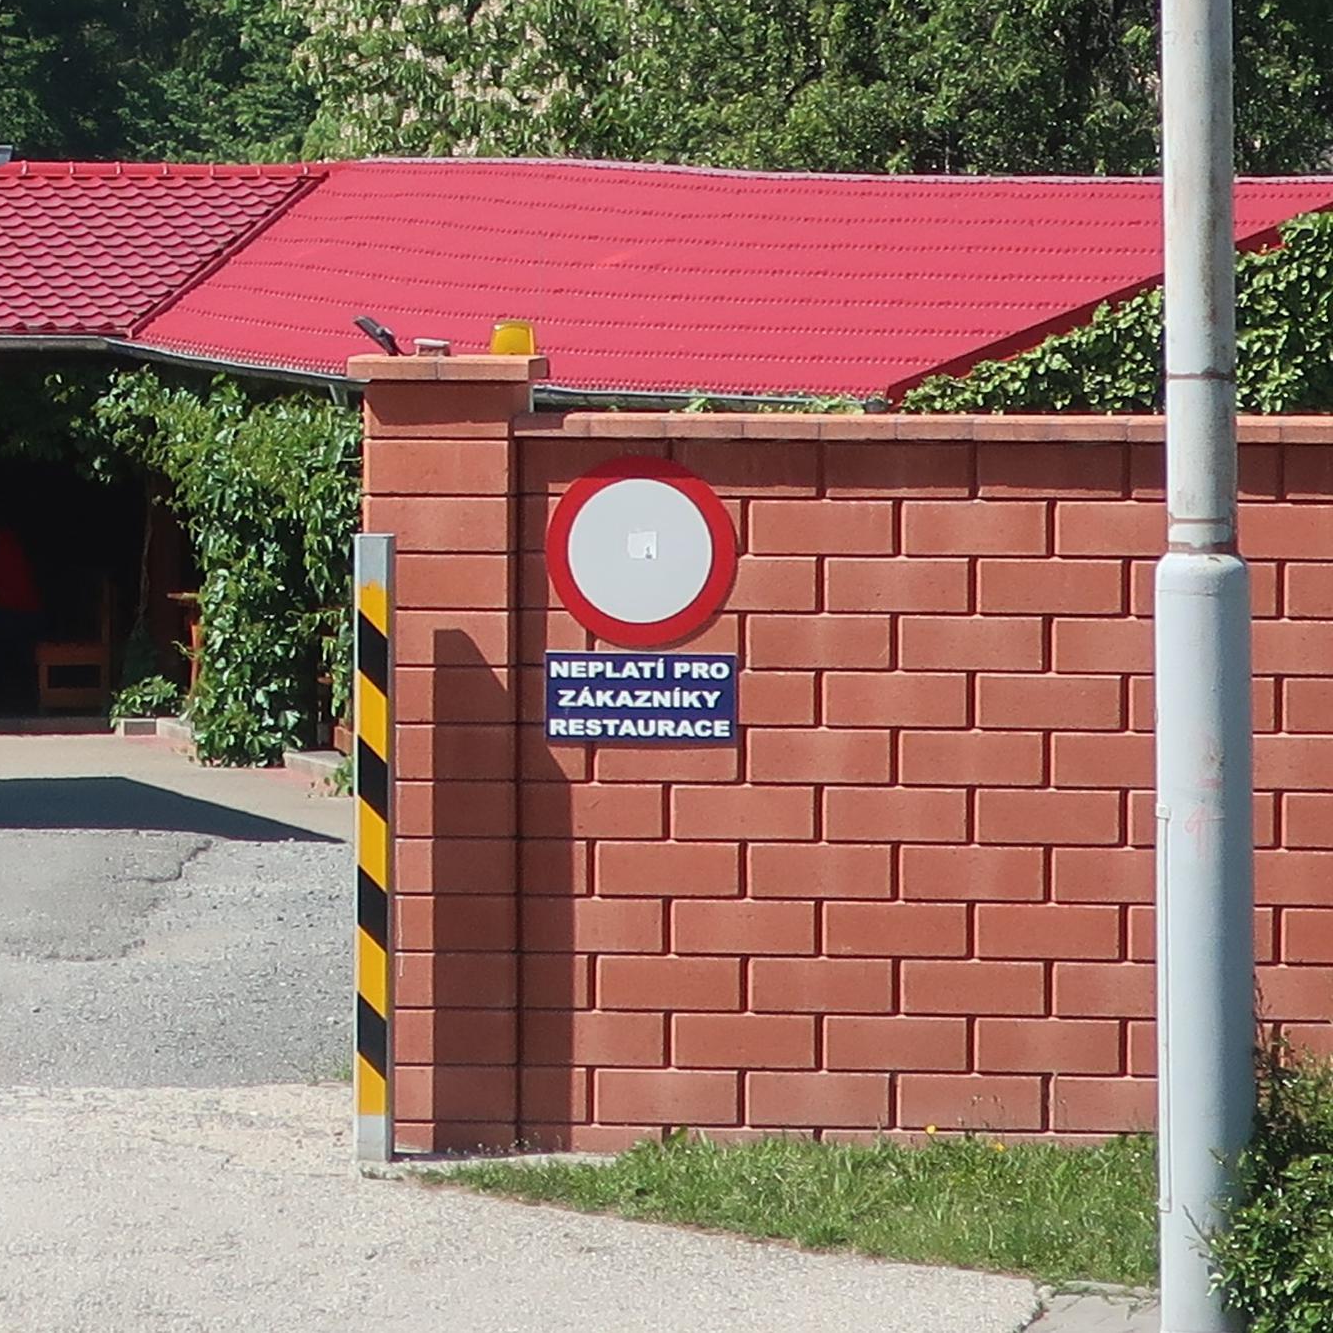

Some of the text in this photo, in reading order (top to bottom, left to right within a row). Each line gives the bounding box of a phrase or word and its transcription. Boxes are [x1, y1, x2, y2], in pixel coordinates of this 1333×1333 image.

[550, 658, 730, 679] NEPLATÍ PRO
[557, 686, 721, 708] ZÁKAZNÍKY
[549, 719, 730, 737] RESTAURACE
